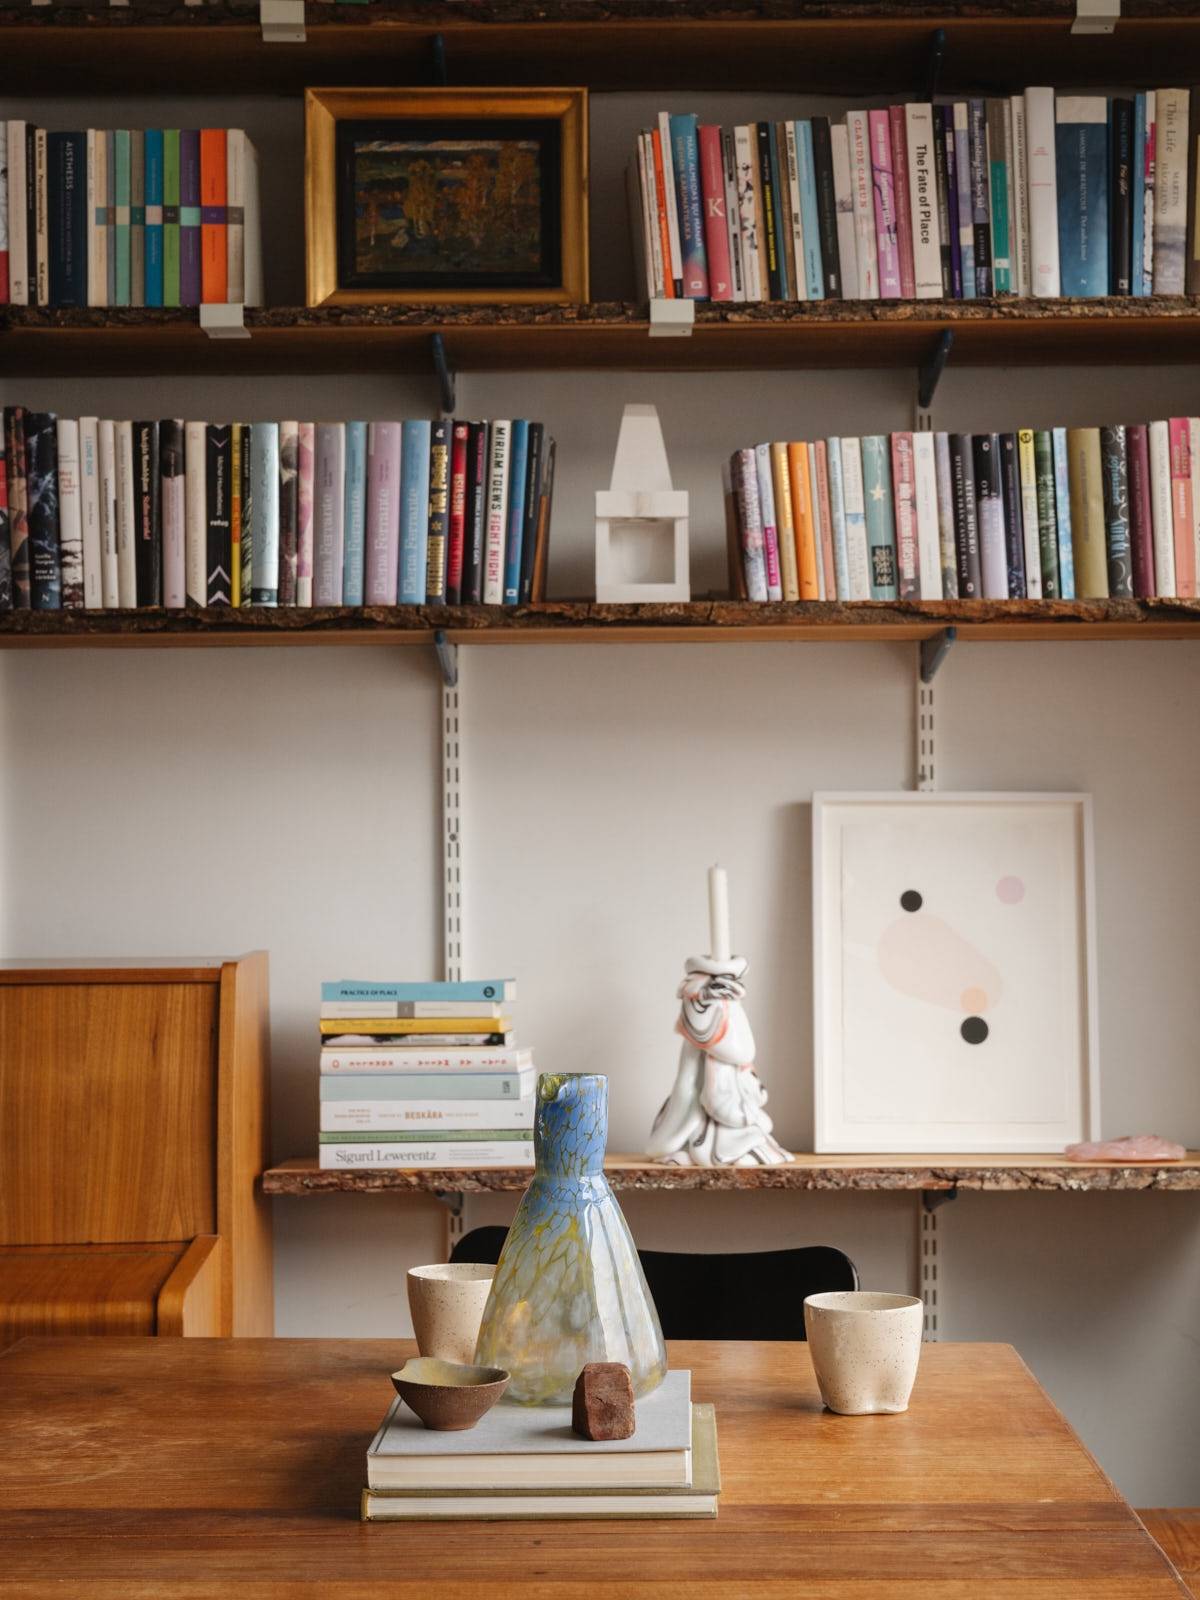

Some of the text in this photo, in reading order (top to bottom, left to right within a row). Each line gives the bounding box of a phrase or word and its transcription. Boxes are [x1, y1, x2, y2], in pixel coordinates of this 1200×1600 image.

[65, 141, 74, 190] AISTHESIS
[854, 119, 868, 208] CLAUDE CAHUN
[1166, 101, 1177, 152] This Life
[688, 163, 698, 200] ALMEIDAS
[693, 218, 702, 247] MÅNAR
[916, 145, 932, 244] The Fate of Place
[1172, 171, 1180, 207] MARTIN
[319, 494, 333, 600] Elena Ferrante
[347, 491, 361, 596] Elena Ferrante
[373, 489, 389, 595] Elena Ferrante
[403, 488, 418, 595] Elena Ferrante
[488, 427, 505, 584] MIRIAM TOEWS FIGHT NIGHT
[965, 479, 977, 554] ALICE MUNRO
[960, 555, 968, 578] ROCK
[335, 1150, 374, 1164] Sigurd
[376, 1150, 437, 1162] Lewerentz
